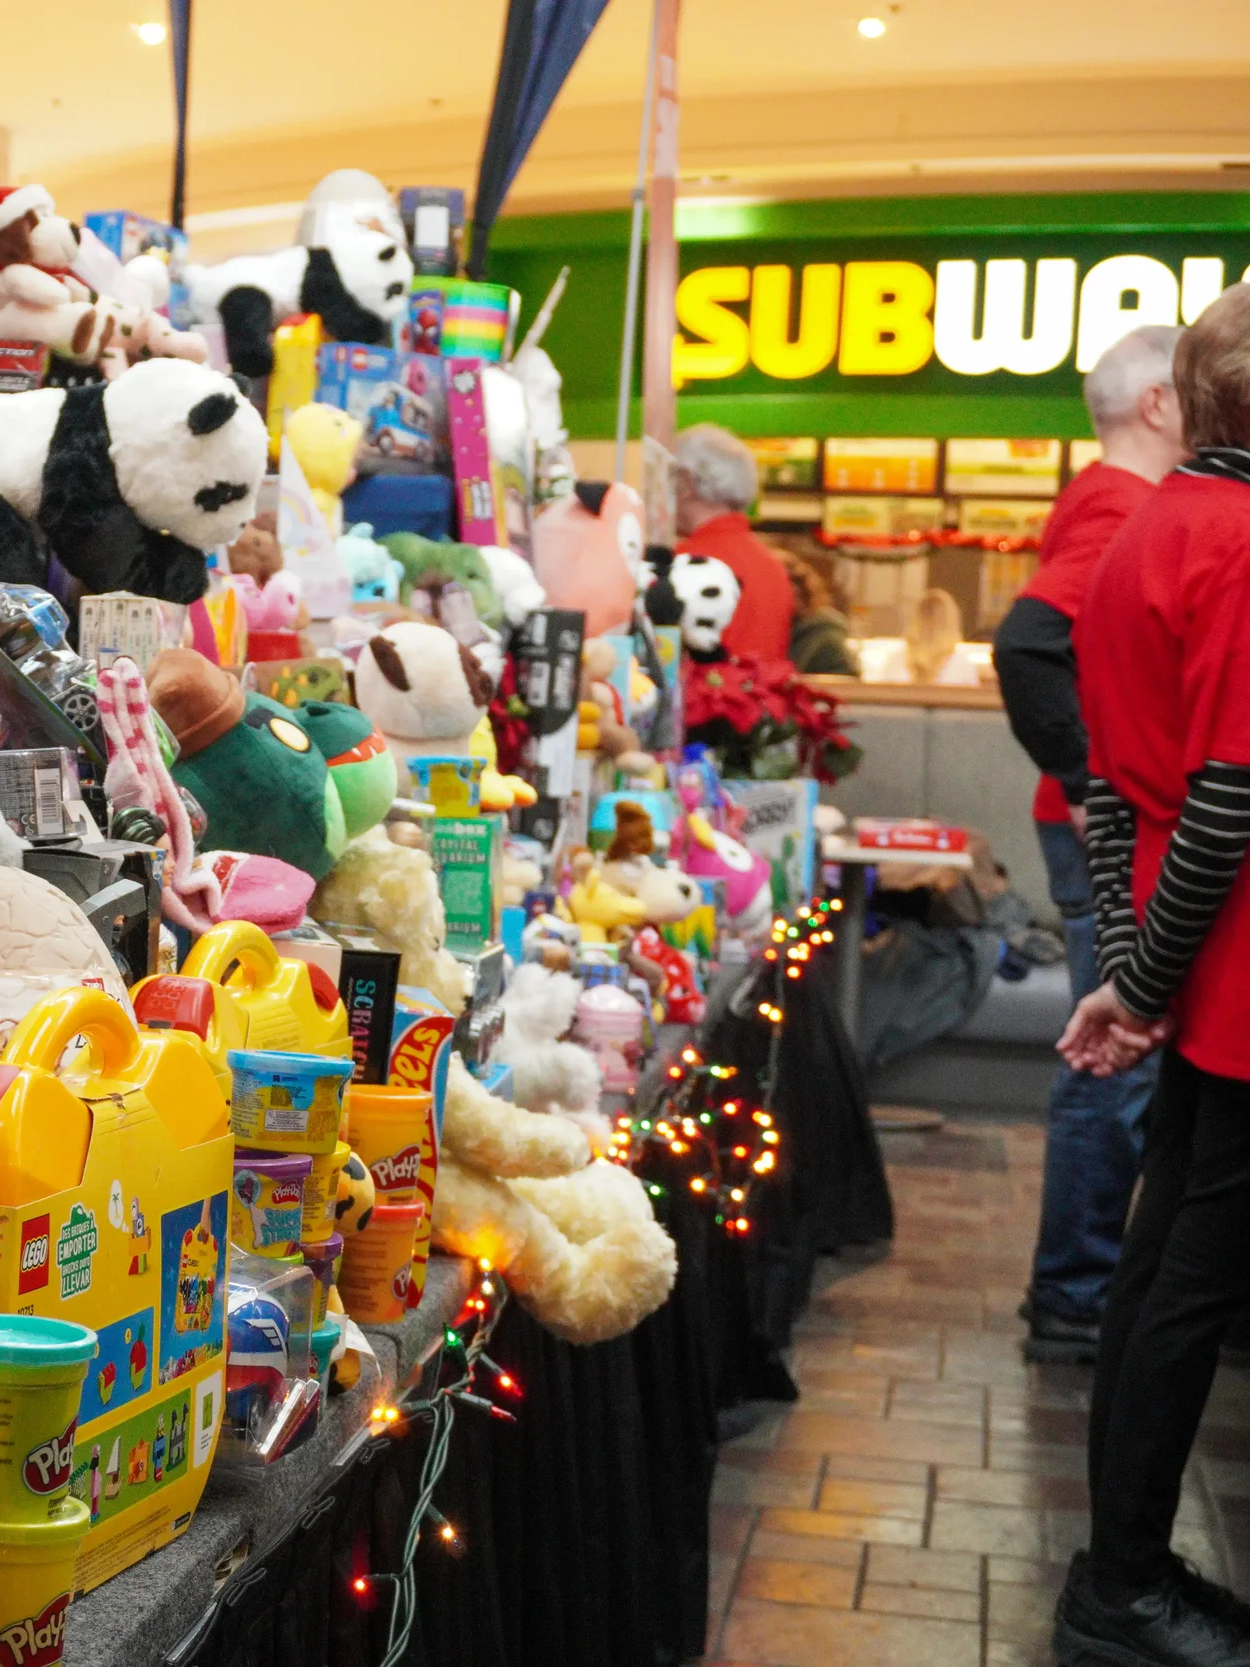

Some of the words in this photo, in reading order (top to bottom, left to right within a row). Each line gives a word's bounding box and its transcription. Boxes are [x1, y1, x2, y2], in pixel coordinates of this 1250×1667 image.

[350, 979, 377, 1079] SCRATCH
[62, 1227, 71, 1240] DES
[71, 1220, 89, 1238] BRIQUES
[21, 1235, 48, 1272] LEGO
[58, 1232, 96, 1262] EMPORTER
[62, 1272, 91, 1295] LLEVAR
